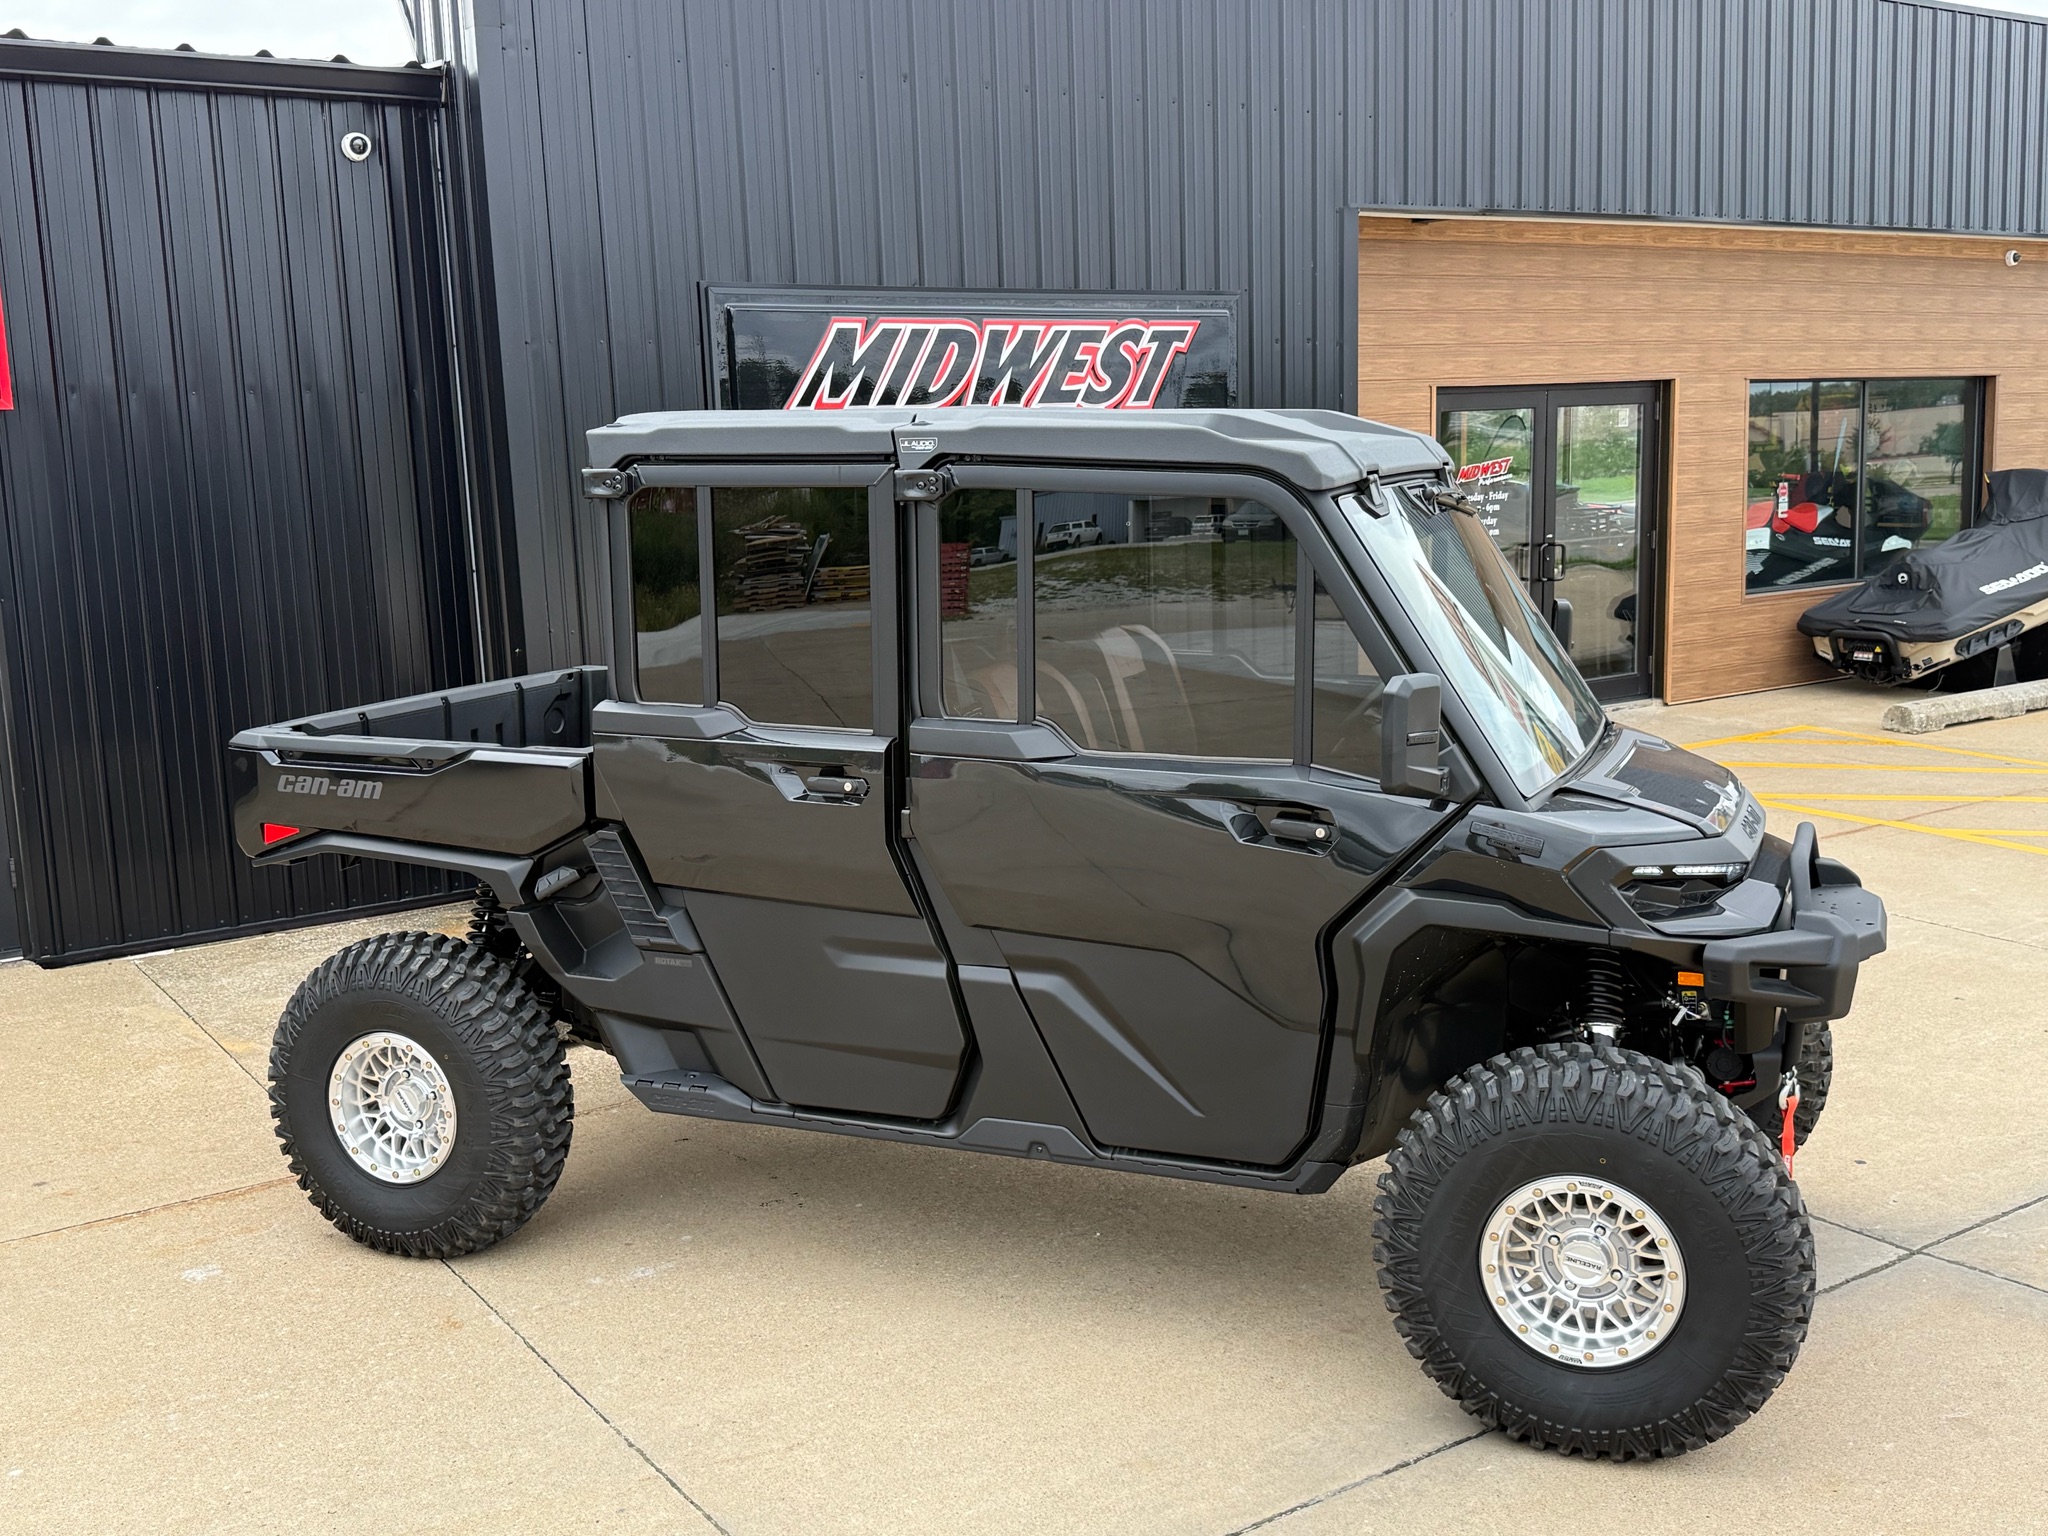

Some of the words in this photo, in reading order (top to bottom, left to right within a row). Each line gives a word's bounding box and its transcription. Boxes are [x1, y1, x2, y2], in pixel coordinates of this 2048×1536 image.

[787, 317, 1200, 410] MIDWEST
[1456, 456, 1513, 484] MIDWEST
[1489, 490, 1509, 501] Friday
[1486, 502, 1500, 513] 6pm
[277, 774, 383, 800] can-am
[1473, 823, 1541, 847] DEFENDER
[655, 957, 681, 966] ROTAX
[1565, 1255, 1602, 1271] RACELINE
